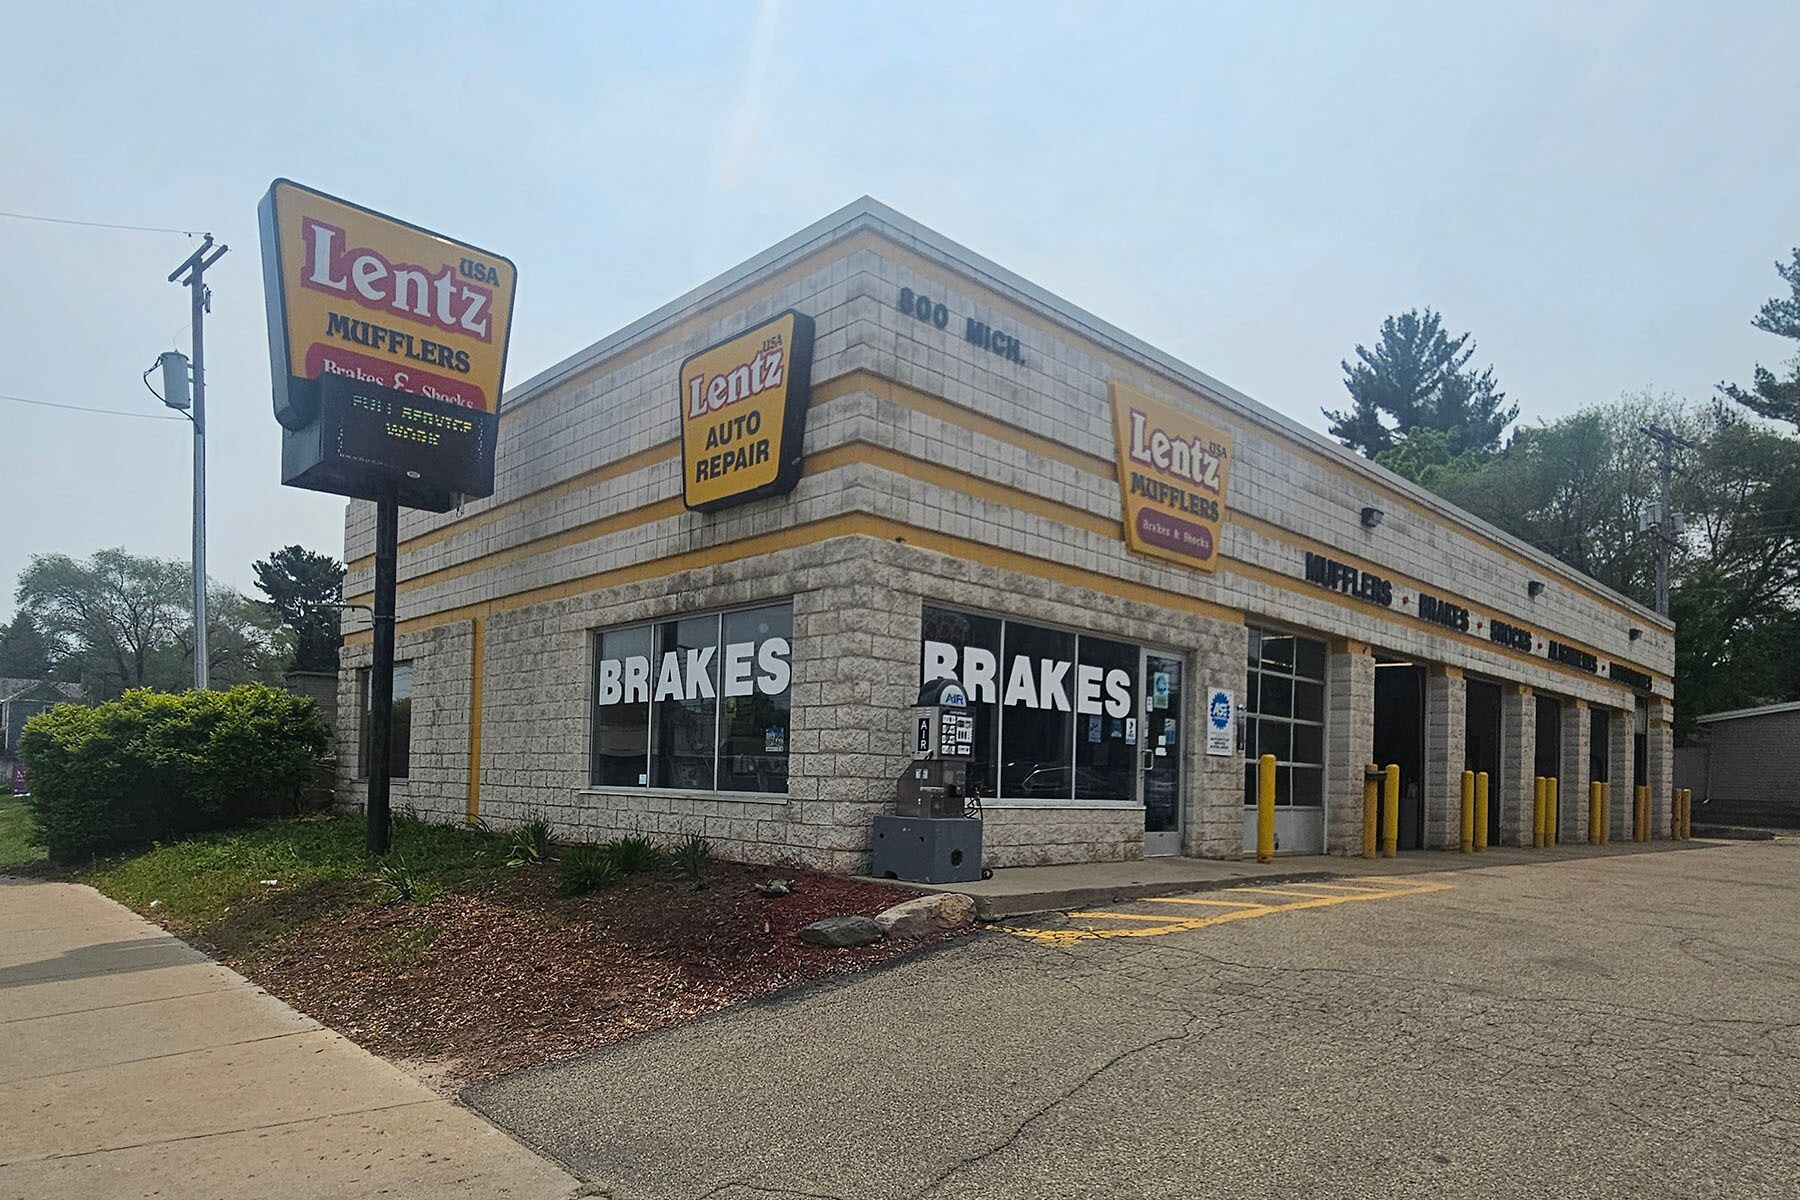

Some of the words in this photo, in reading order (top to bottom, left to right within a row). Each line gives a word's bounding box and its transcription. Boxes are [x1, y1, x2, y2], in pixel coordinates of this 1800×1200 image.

[307, 222, 489, 340] Lentz
[459, 257, 500, 288] USA
[899, 286, 949, 330] 800
[326, 311, 471, 375] MUFFLERS
[762, 333, 784, 353] USA
[322, 358, 384, 387] Brakes
[421, 384, 475, 410] Shocks
[688, 349, 784, 421] Lentz
[705, 410, 762, 451] AUTO
[1130, 410, 1221, 493] Lentz
[1208, 440, 1228, 460] USA
[695, 438, 770, 484] REPAIR
[1130, 471, 1220, 523] MUFFLERS
[1142, 518, 1172, 538] Brakes
[1173, 528, 1180, 541] &
[1183, 530, 1210, 550] Shocks
[1305, 551, 1394, 608] MUFFLERS
[598, 636, 792, 707] BRAKES
[924, 640, 1132, 719] BRAKES
[945, 693, 965, 705] AIR
[919, 720, 929, 750] AIR
